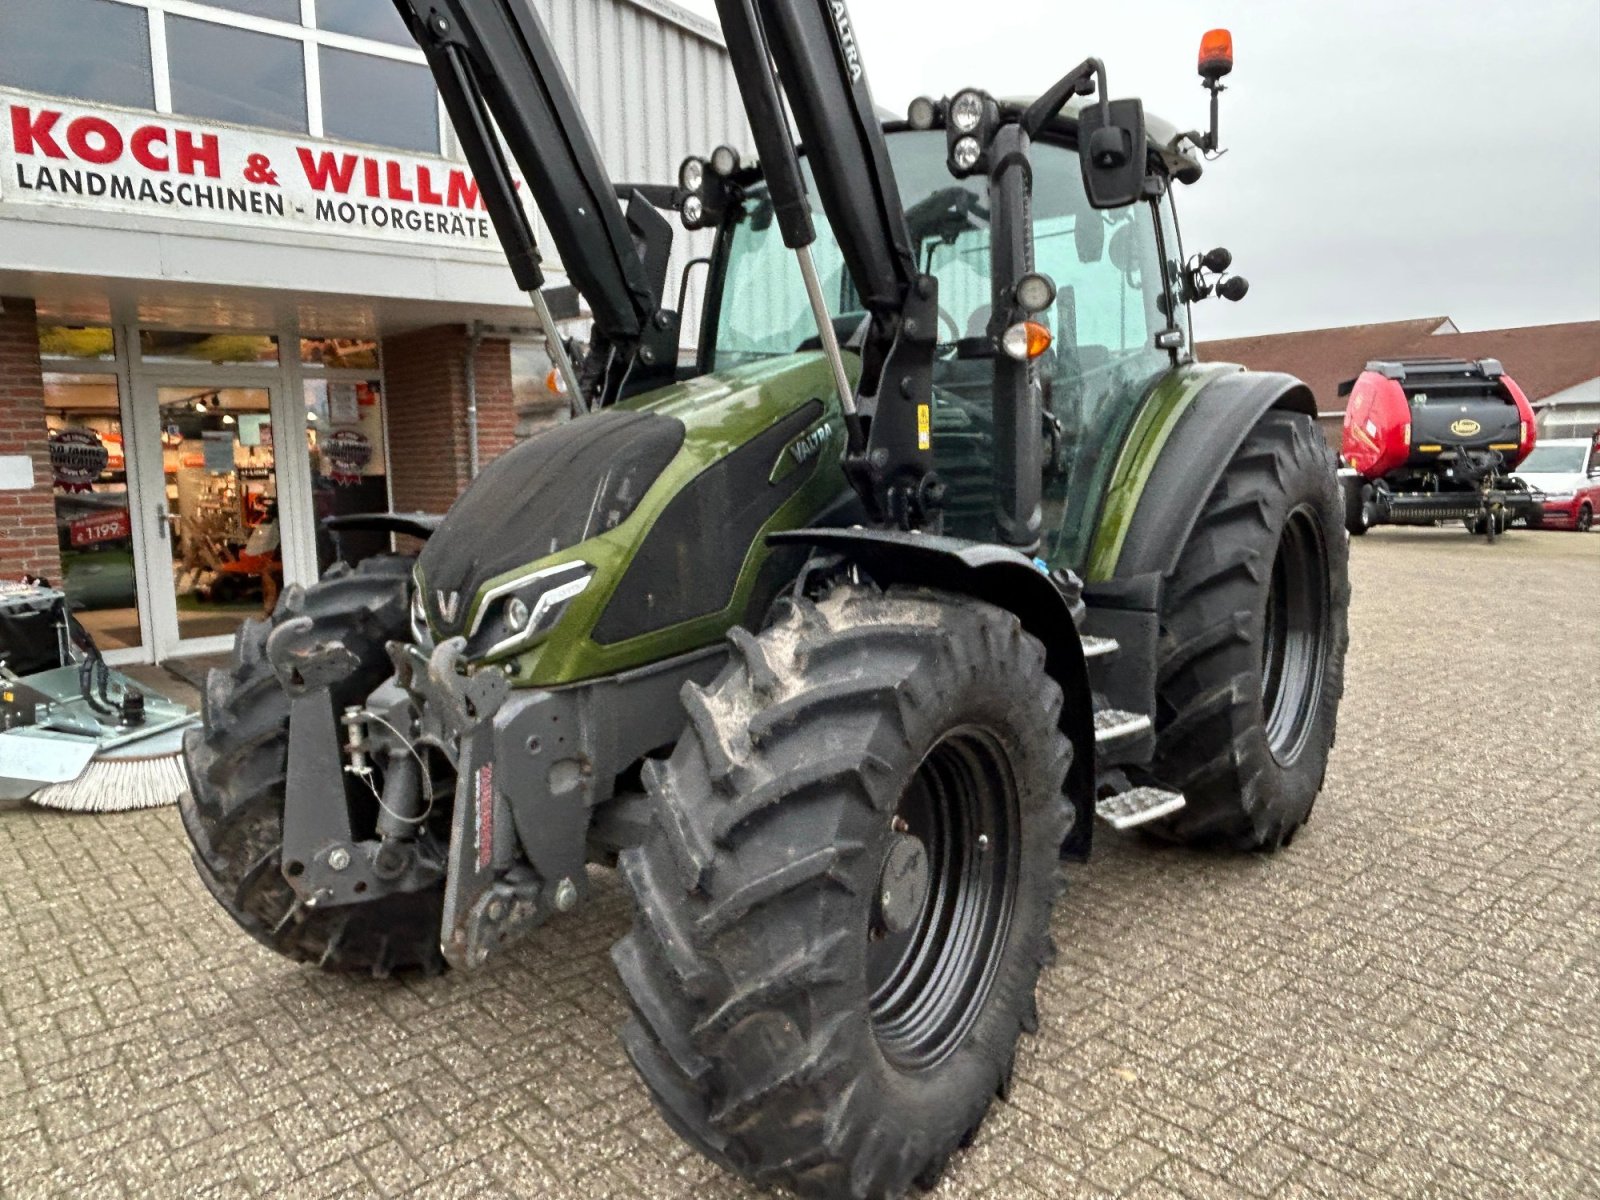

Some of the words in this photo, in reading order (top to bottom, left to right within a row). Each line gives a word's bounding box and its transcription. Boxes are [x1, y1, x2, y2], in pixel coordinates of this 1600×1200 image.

[831, 0, 862, 84] ALTRA
[10, 105, 221, 178] KOCH
[242, 152, 281, 187] &
[296, 146, 521, 212] WILLM
[16, 163, 285, 217] LANDMASCHINEN
[315, 203, 489, 238] MOTORGERÄTE
[790, 422, 833, 464] VALTRA
